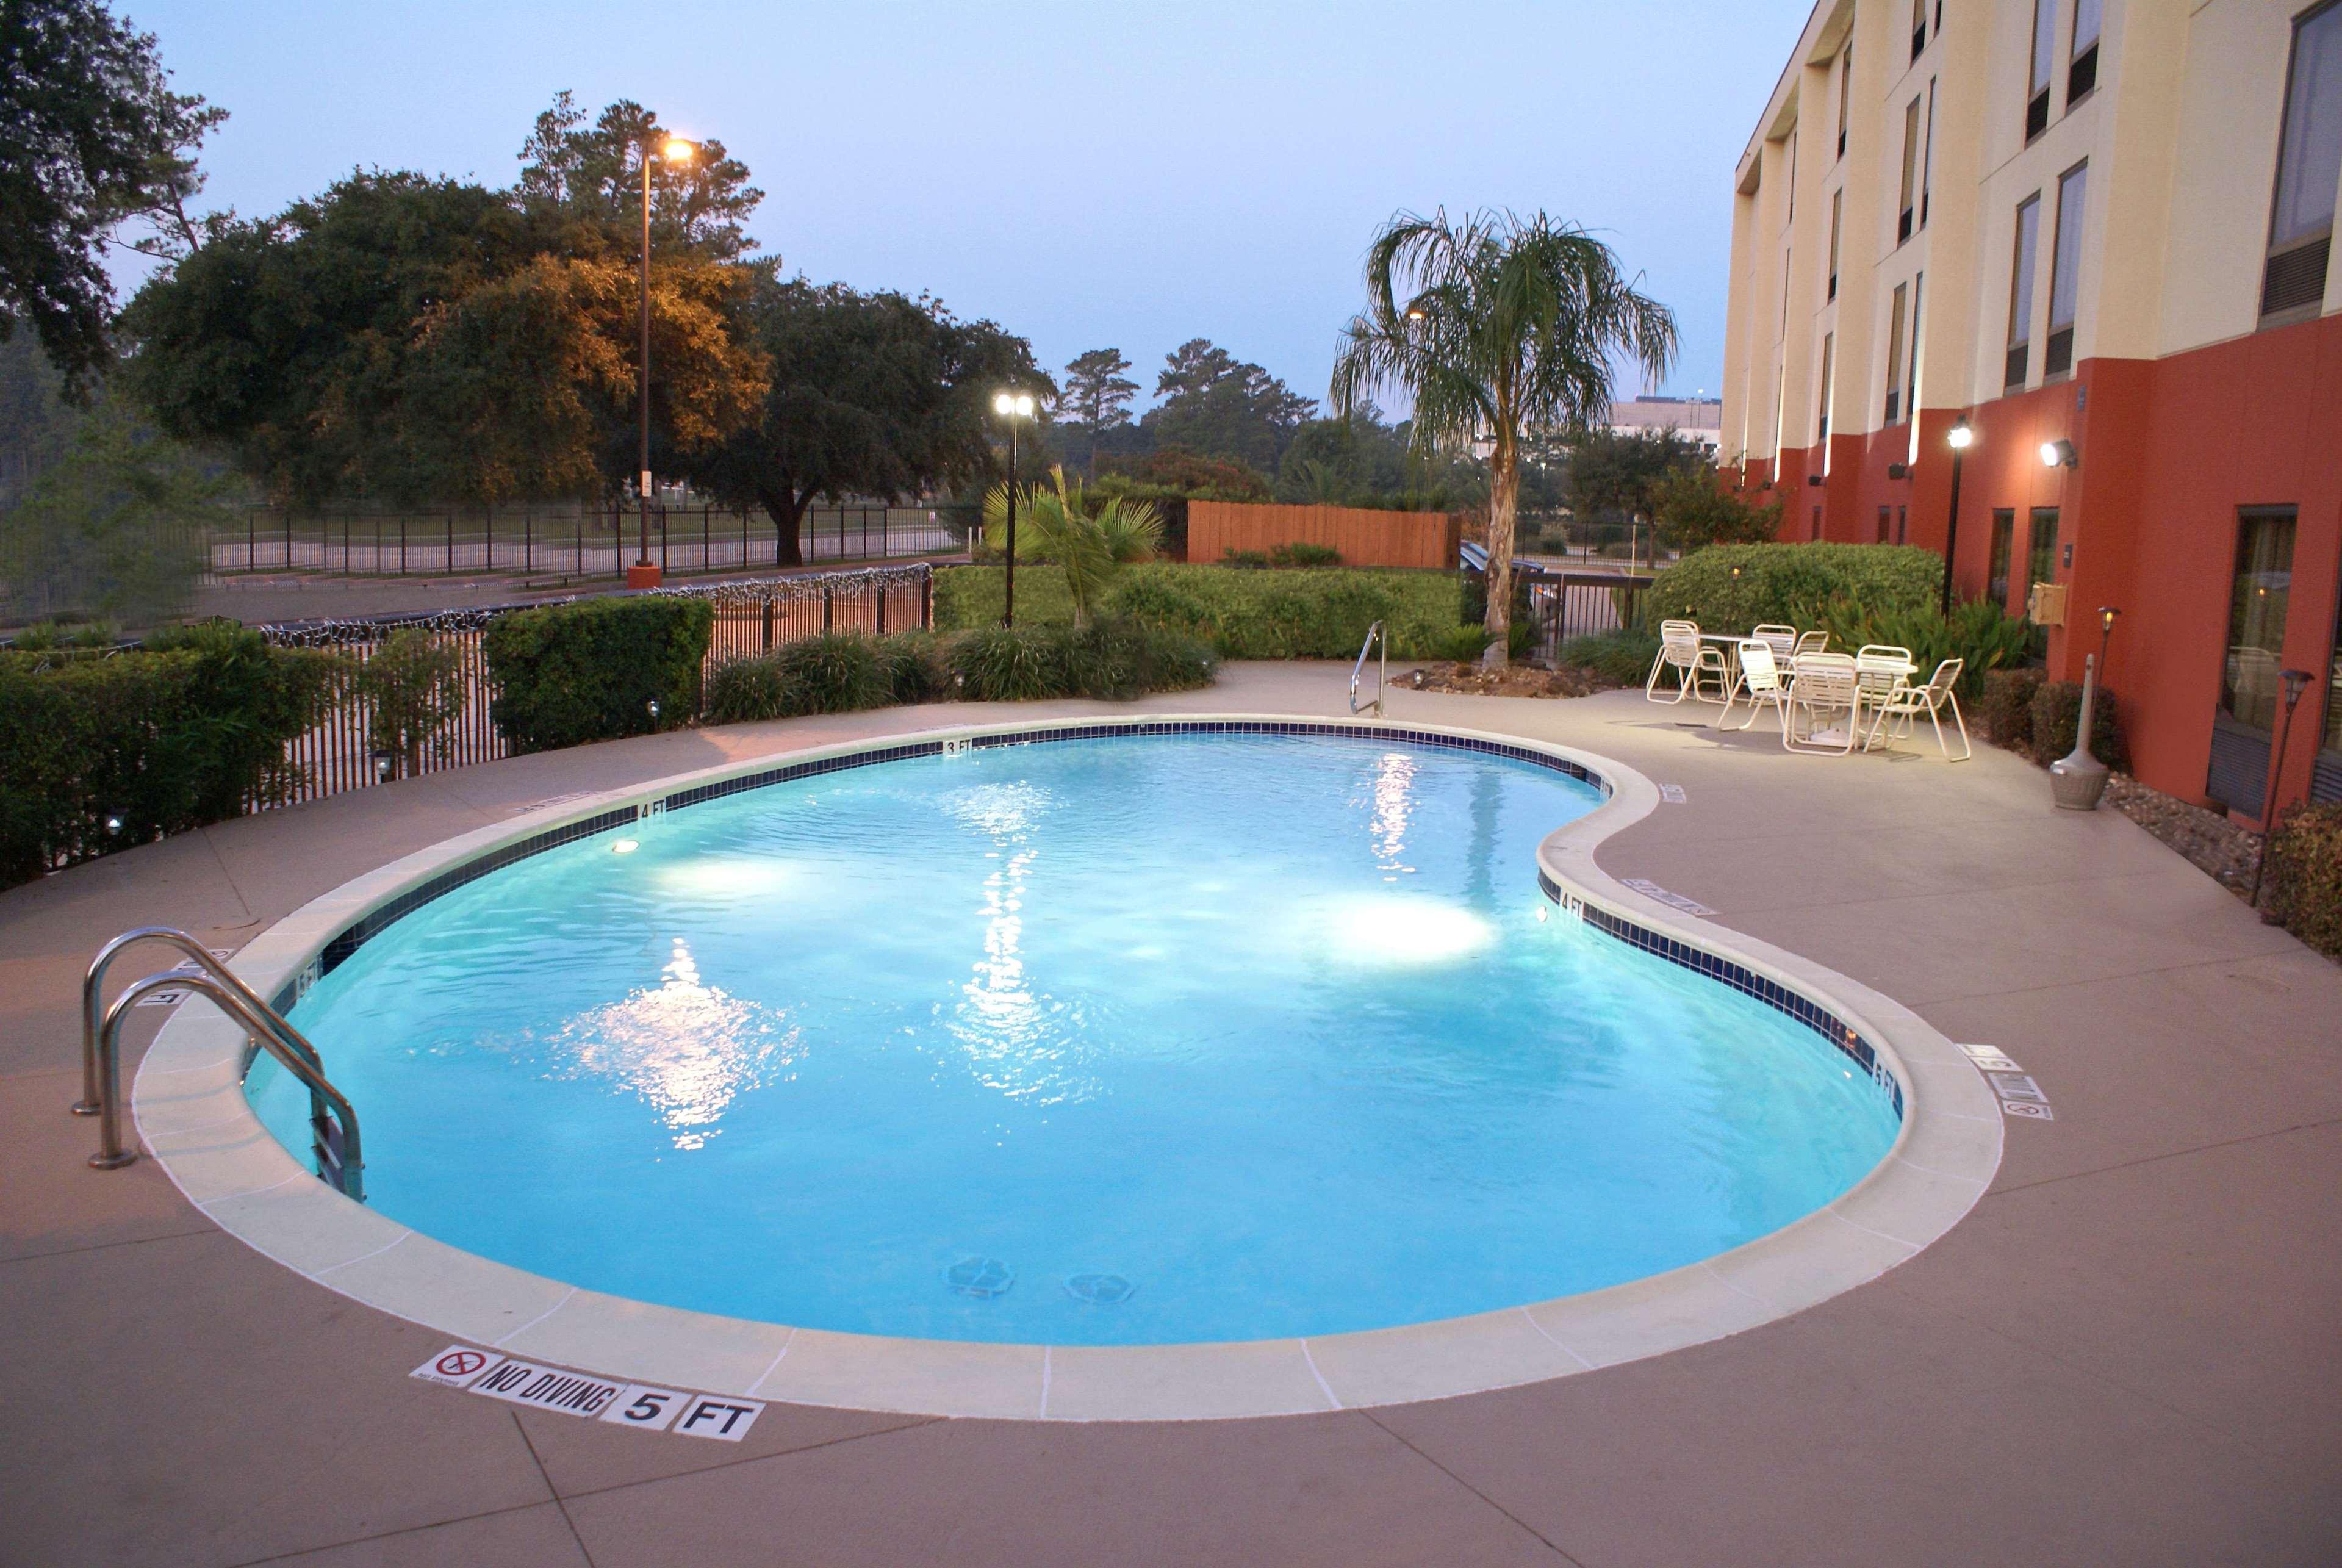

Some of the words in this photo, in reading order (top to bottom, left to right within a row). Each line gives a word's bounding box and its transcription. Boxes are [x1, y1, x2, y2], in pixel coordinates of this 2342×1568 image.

[948, 742, 954, 754] 3
[959, 739, 971, 753] FT
[642, 804, 648, 818] 4
[653, 799, 664, 815] FT
[1562, 893, 1568, 909] 4
[1571, 896, 1582, 918] FT
[1883, 1070, 1894, 1099] FT
[478, 1364, 524, 1392] NO
[519, 1373, 616, 1412] DIVING
[624, 1392, 671, 1421] 5
[683, 1401, 754, 1434] FT
